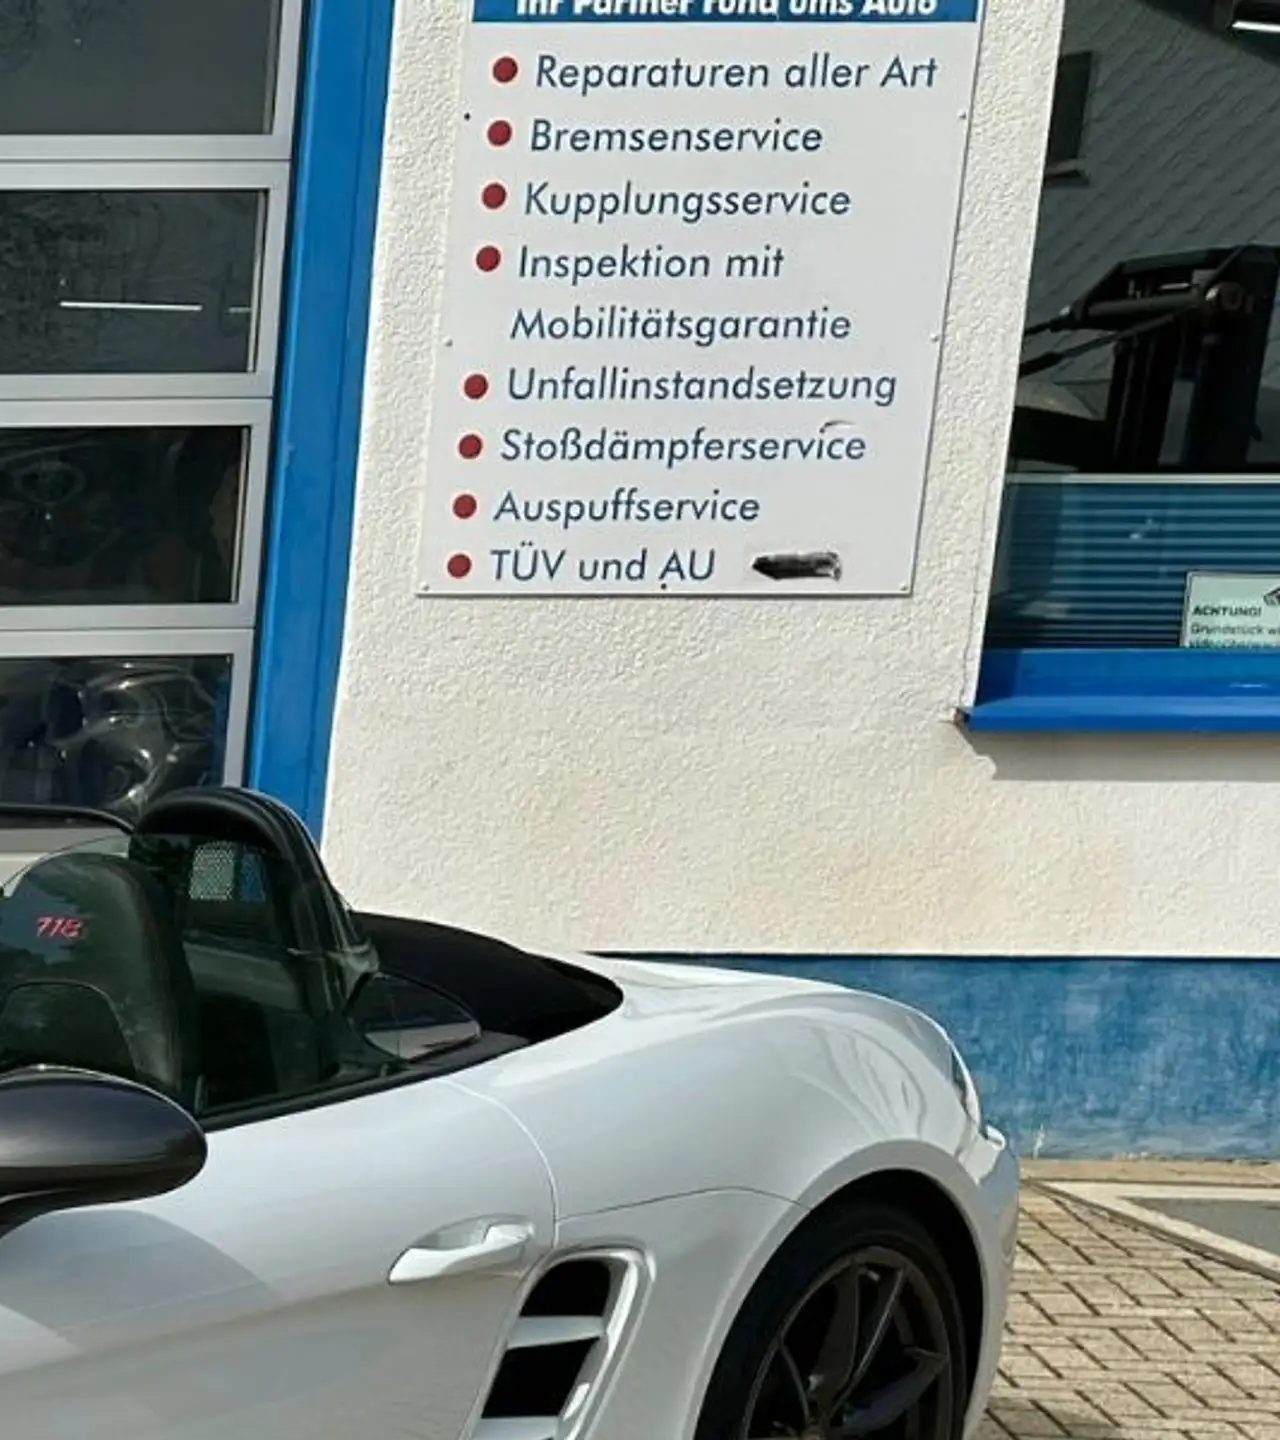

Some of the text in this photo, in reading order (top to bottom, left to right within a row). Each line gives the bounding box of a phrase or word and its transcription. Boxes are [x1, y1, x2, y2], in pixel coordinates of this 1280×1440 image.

[536, 52, 938, 95] Reparaturen aller Art
[530, 117, 822, 152] Bremsenservice
[524, 181, 852, 224] Kupplungsservice
[518, 244, 785, 285] Inspektion mit
[509, 305, 852, 347] Mobilitätsgarantie
[507, 368, 897, 406] Unfallinstandsetzung
[500, 427, 866, 468] Stoßdämpferservice
[493, 488, 761, 528] Auspuffservice
[490, 541, 716, 580] TÜV und AU
[1193, 606, 1262, 616] ACHTUNG!
[36, 916, 83, 938] 718
